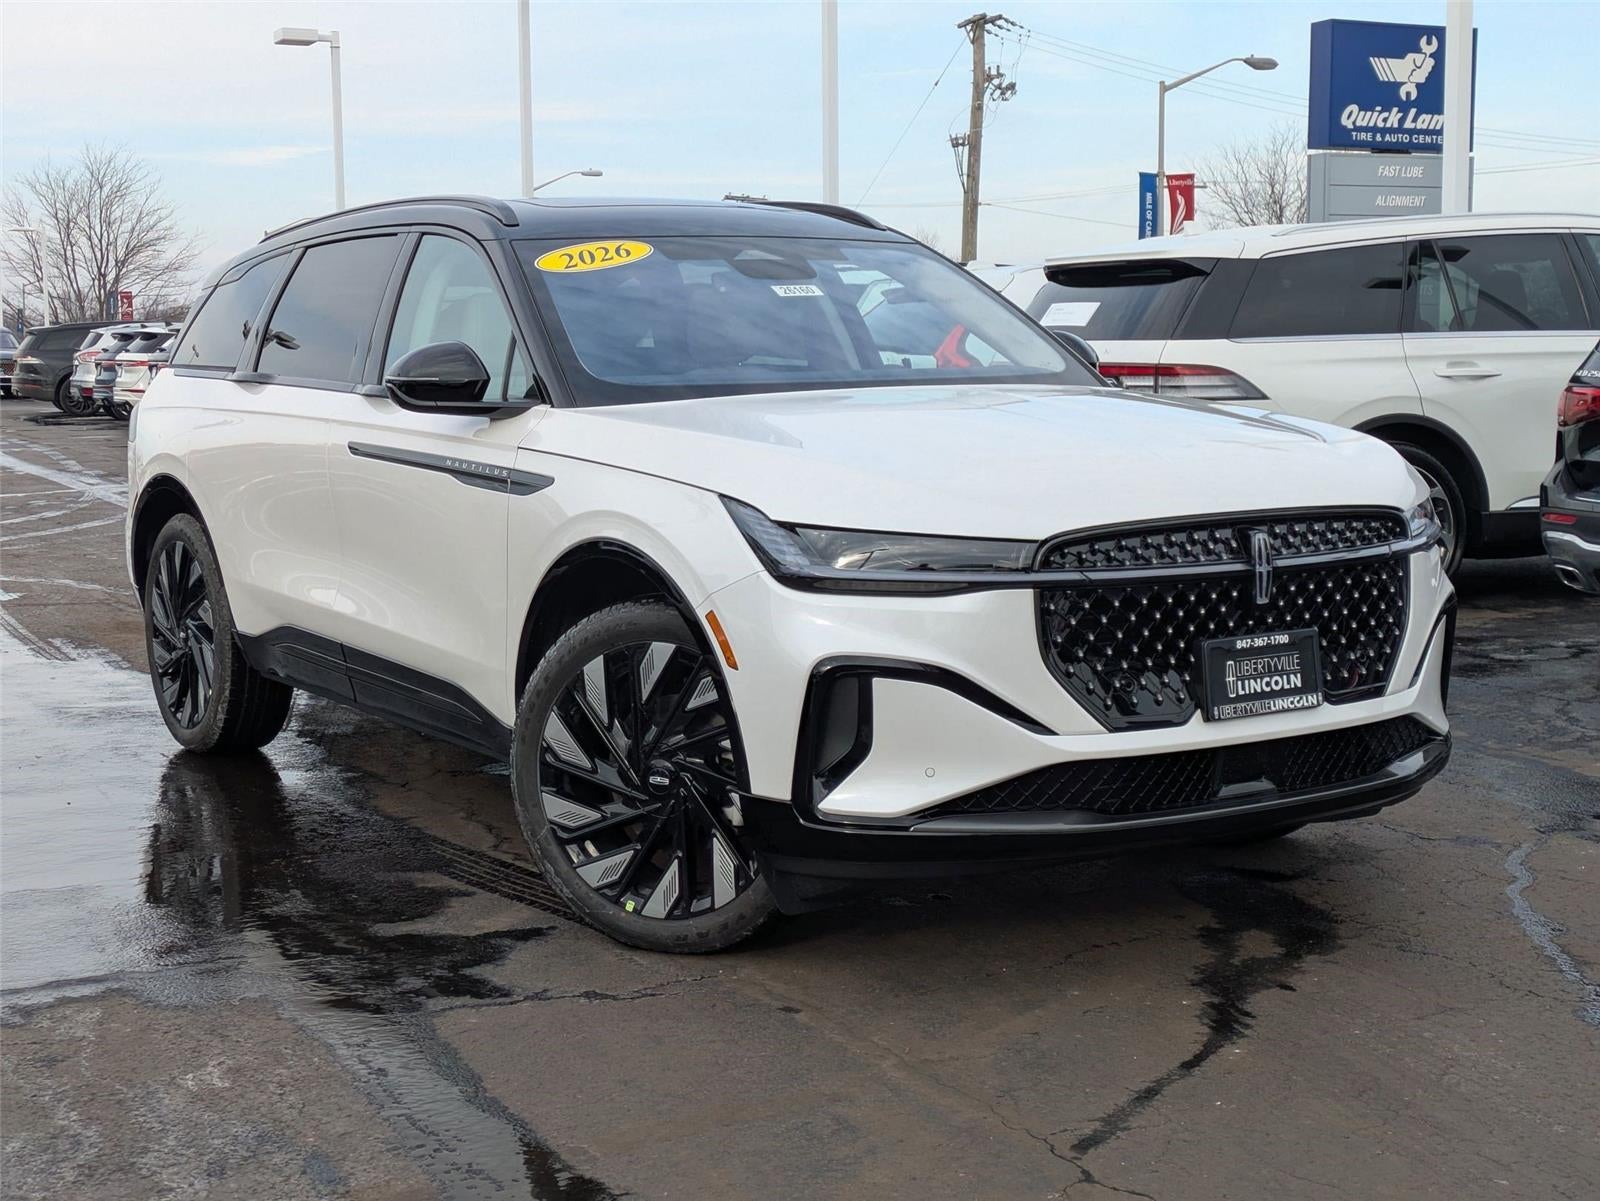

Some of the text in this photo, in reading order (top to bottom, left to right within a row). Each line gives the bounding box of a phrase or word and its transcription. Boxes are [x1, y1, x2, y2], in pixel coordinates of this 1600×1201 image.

[1341, 103, 1444, 130] Quick Lan
[1351, 131, 1444, 144] TIRE & AUTO CENTE
[1377, 165, 1424, 178] FAST LUBE
[1375, 194, 1426, 207] ALIGNMENT
[559, 243, 632, 270] 2026
[779, 286, 816, 295] 26160
[446, 459, 509, 477] NAUTILUS
[1236, 634, 1289, 649] 847-367-1700
[1236, 654, 1301, 676] LIBERTYVILLE
[1237, 673, 1302, 695] LINCOLN
